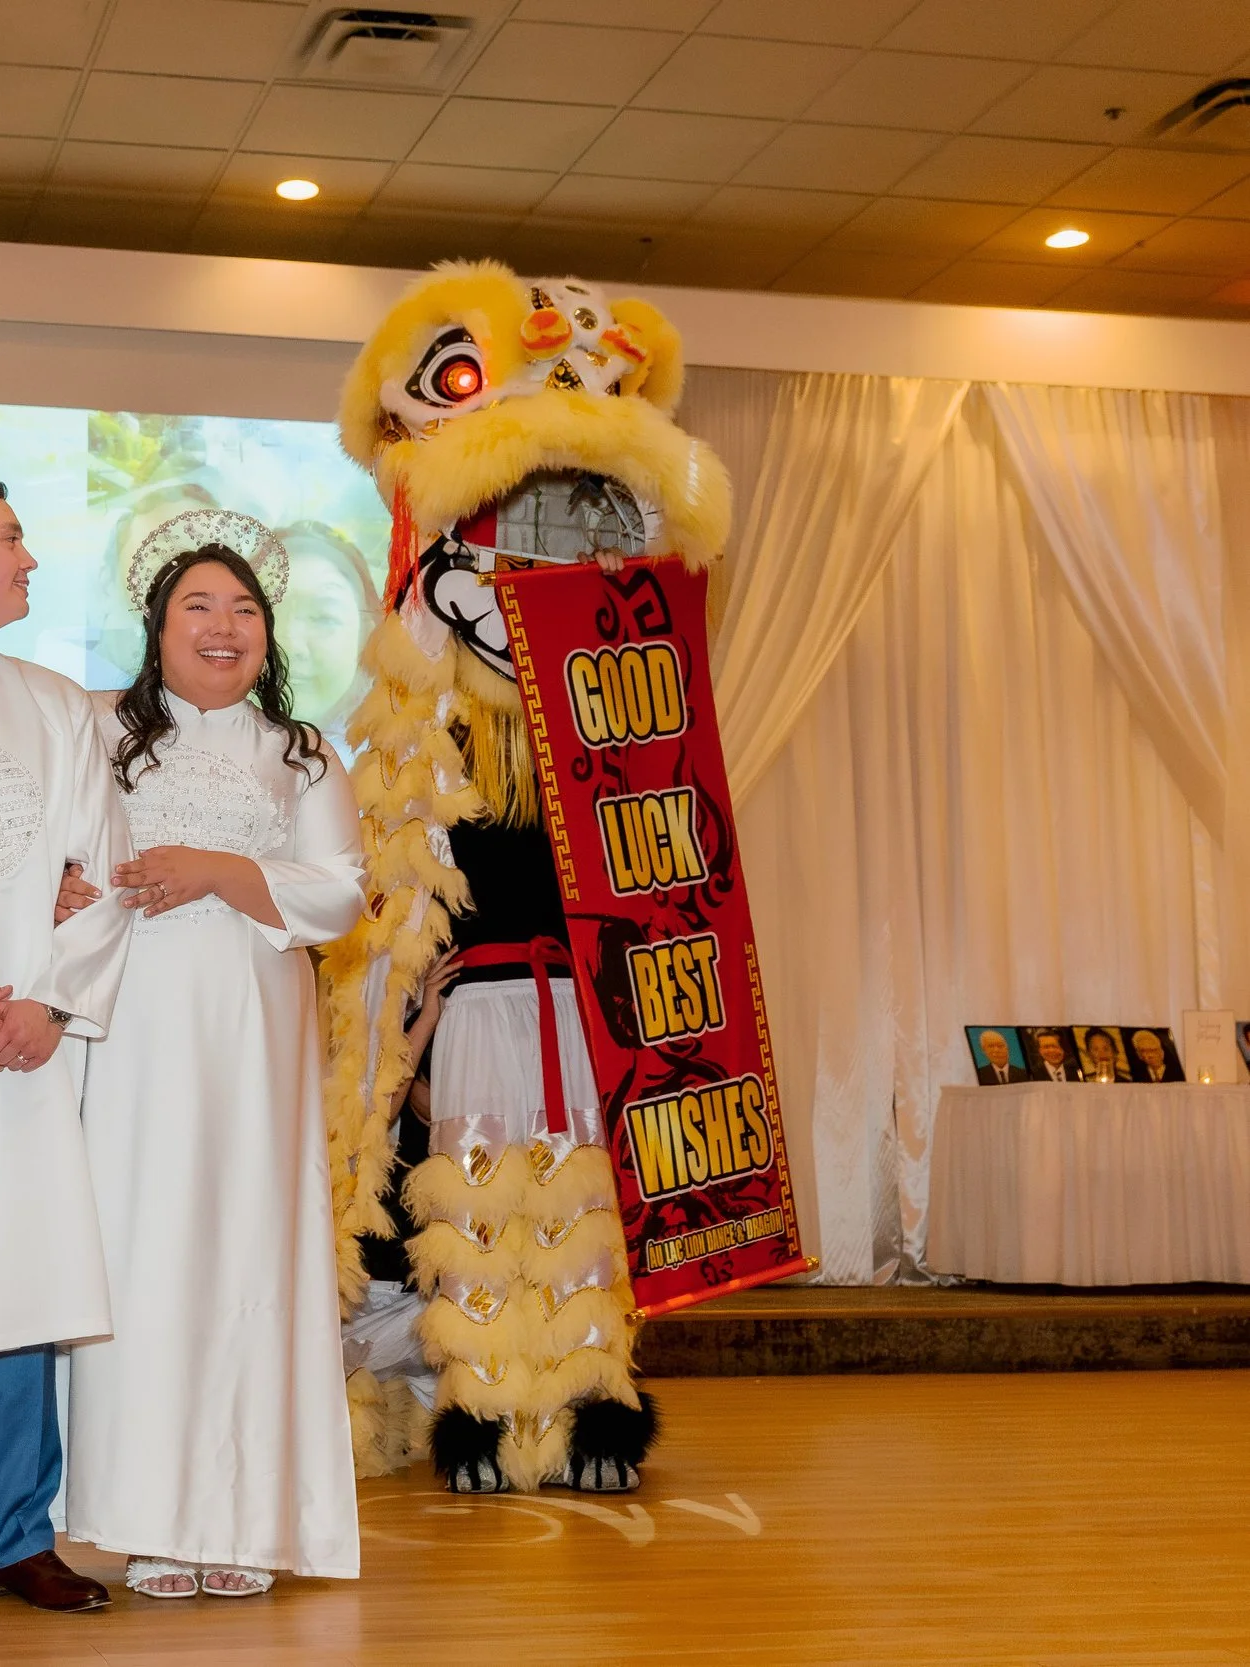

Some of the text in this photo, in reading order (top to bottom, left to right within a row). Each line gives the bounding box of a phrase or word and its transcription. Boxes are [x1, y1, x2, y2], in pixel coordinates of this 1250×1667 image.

[567, 643, 685, 746] GOOD
[599, 790, 705, 893] LUCK
[628, 936, 724, 1042] BEST
[627, 1078, 774, 1199] WISHES
[684, 1231, 706, 1259] LION
[705, 1222, 736, 1253] DANCE
[736, 1224, 746, 1243] &
[744, 1209, 783, 1241] DRAGON
